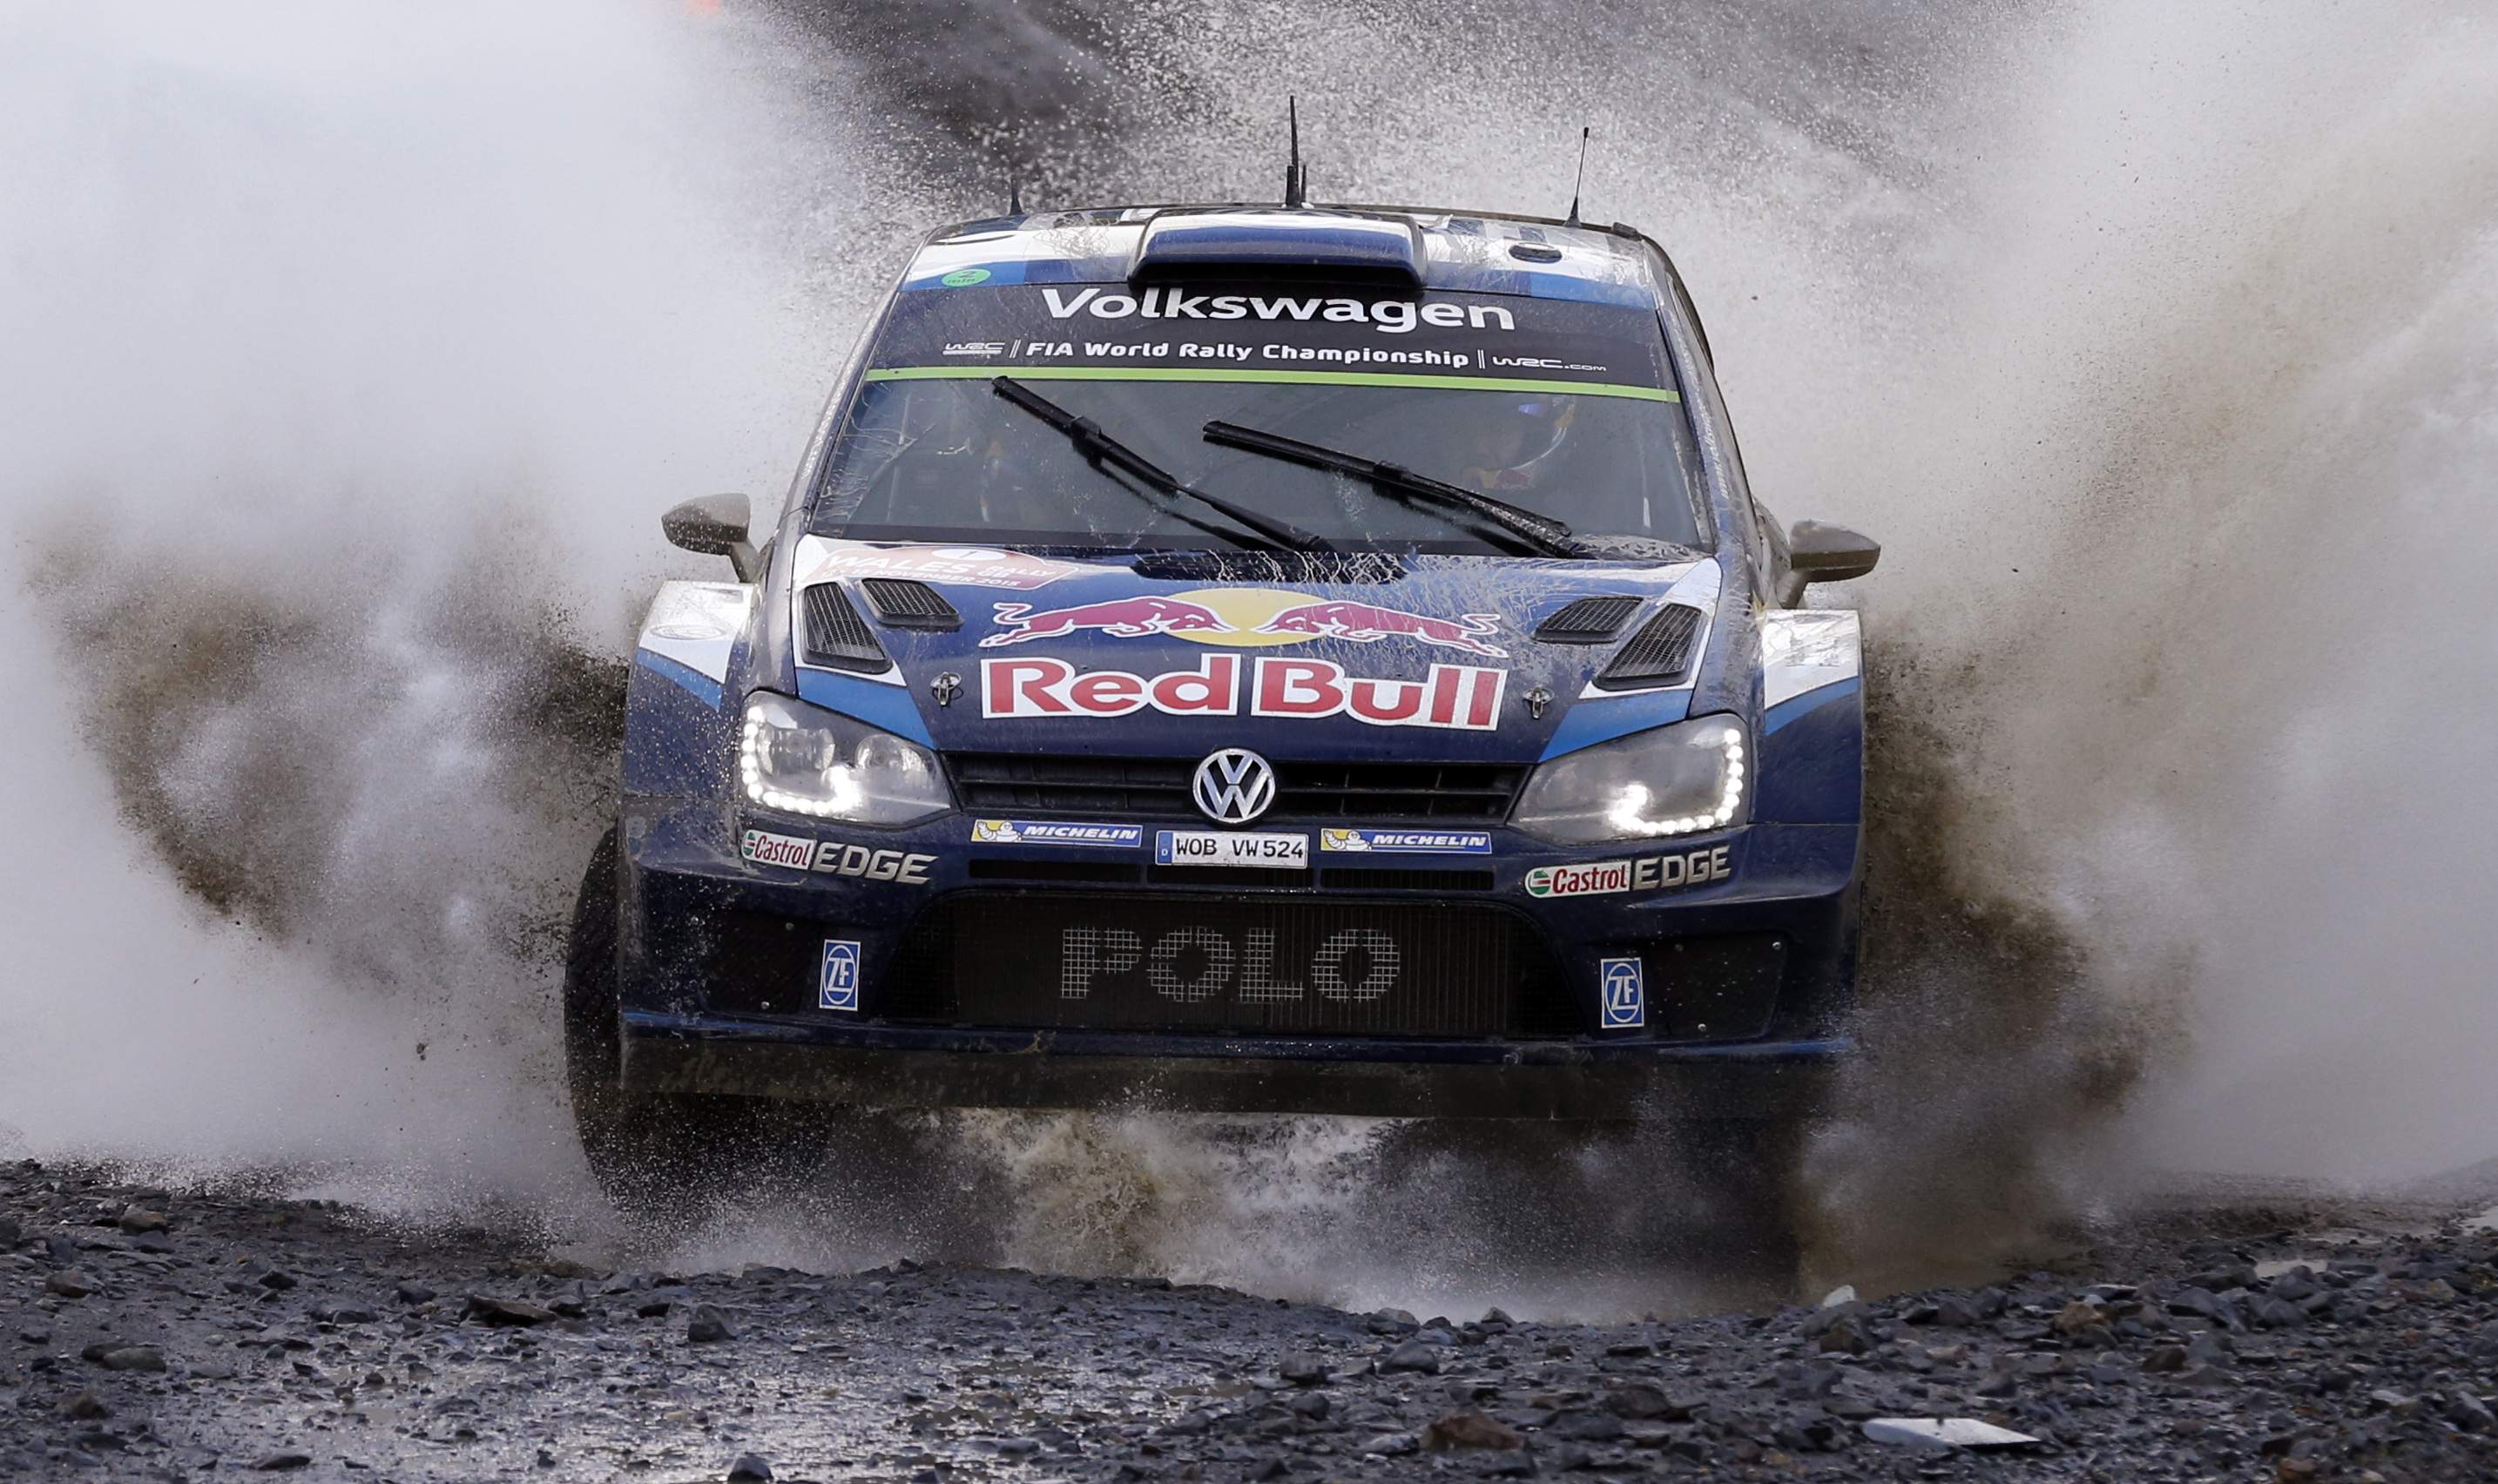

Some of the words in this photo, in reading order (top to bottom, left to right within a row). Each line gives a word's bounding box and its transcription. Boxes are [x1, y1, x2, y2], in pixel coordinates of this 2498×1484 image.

[1042, 287, 1516, 333] Volkswagen
[1025, 342, 1074, 356] FIA
[1084, 342, 1170, 357] World
[1178, 343, 1252, 361] Rally
[1263, 344, 1468, 368] Championship
[829, 556, 976, 574] WALES
[986, 657, 1239, 716] Red
[1256, 659, 1505, 729] Bull
[1023, 826, 1138, 840] MICHELIN
[1176, 839, 1218, 856] WOB
[1373, 833, 1487, 847] MICHELIN
[755, 835, 811, 867] Castrol
[811, 841, 940, 885] EDGE
[1552, 864, 1628, 894] Castrol
[1632, 847, 1732, 890] EDGE
[827, 957, 854, 993] ZF
[1061, 927, 1401, 1004] POLO
[1608, 975, 1638, 1010] ZF
